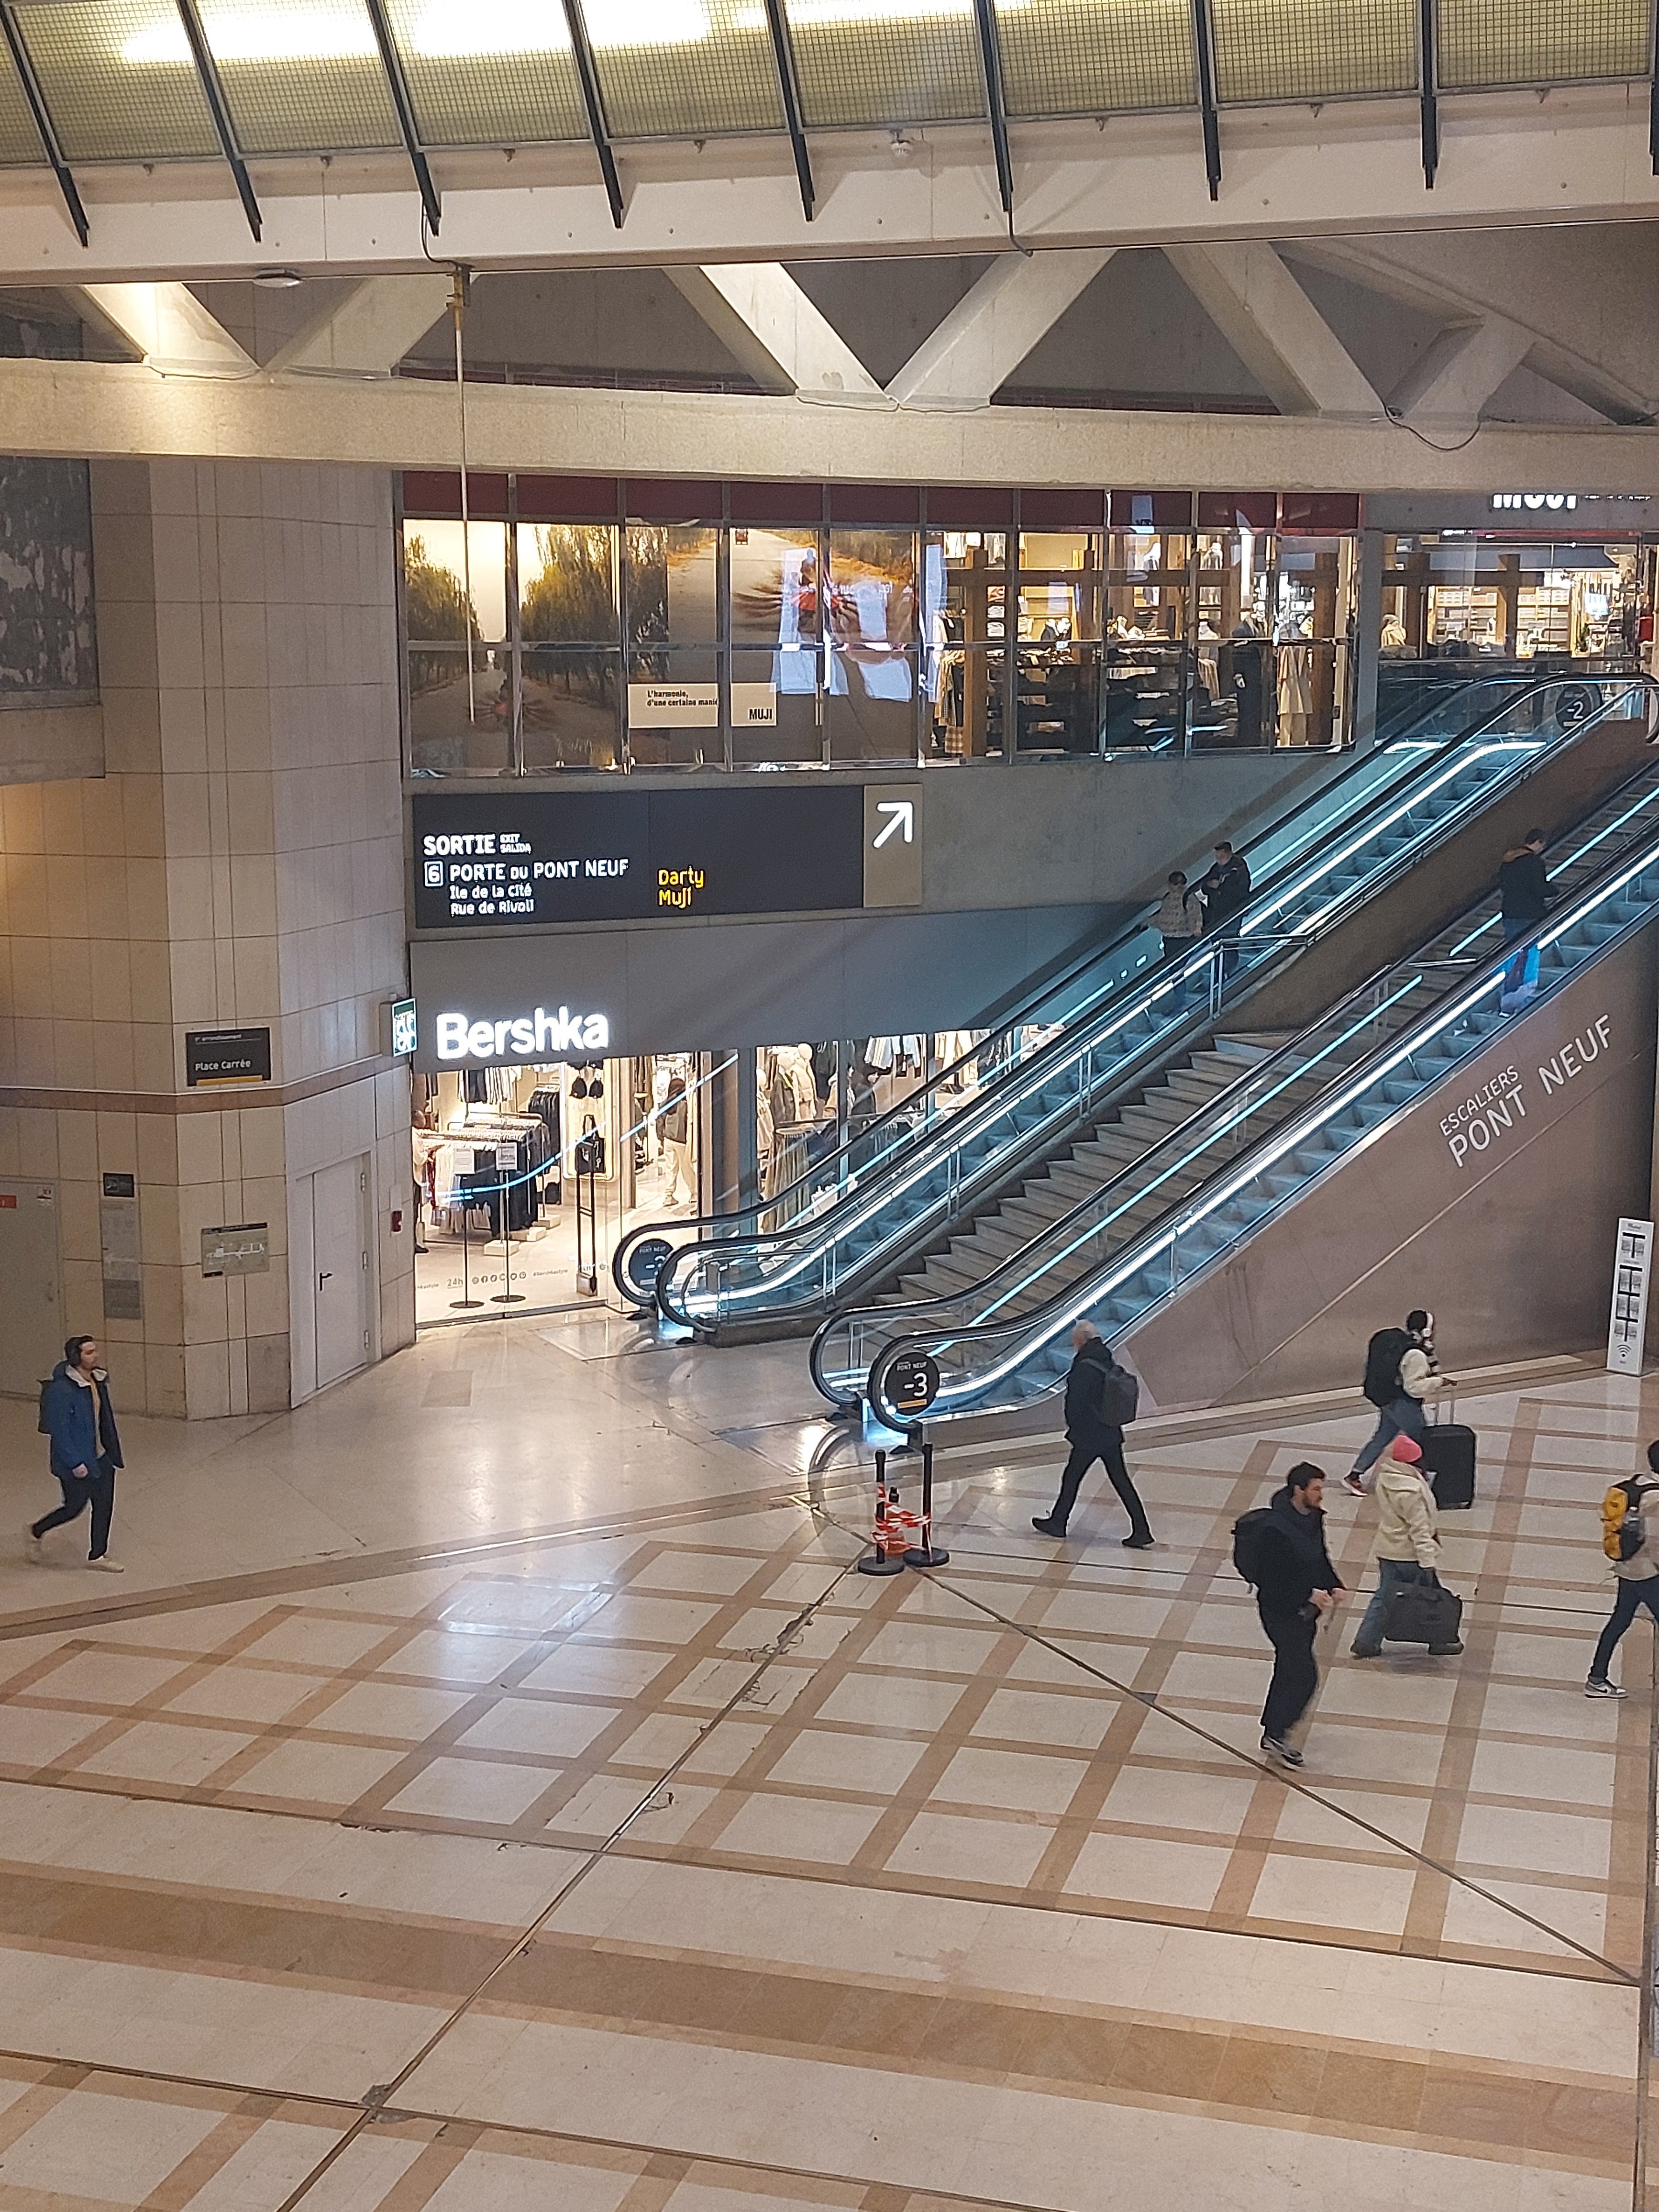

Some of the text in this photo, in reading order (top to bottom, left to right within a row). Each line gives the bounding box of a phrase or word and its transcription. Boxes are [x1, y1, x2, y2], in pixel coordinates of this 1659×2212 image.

[749, 708, 773, 720] MUJI
[1567, 700, 1584, 719] -2
[423, 833, 520, 856] SORTIE EXIT
[499, 843, 532, 853] SALIDA
[428, 865, 441, 883] 6
[449, 863, 506, 882] PORTE
[533, 861, 580, 879] PONT
[585, 858, 629, 877] NEUF
[658, 865, 704, 889] Darty
[472, 885, 488, 899] de
[492, 884, 505, 898] la
[508, 883, 532, 897] Cité
[658, 886, 692, 909] Muji
[450, 899, 534, 916] Rue de Rivoli
[436, 1006, 609, 1060] Bershka
[195, 1059, 251, 1071] Place Carrée
[1438, 1065, 1519, 1137] ESCALIERS
[1448, 1014, 1611, 1167] PONT NEUF
[904, 1372, 928, 1397] -3
